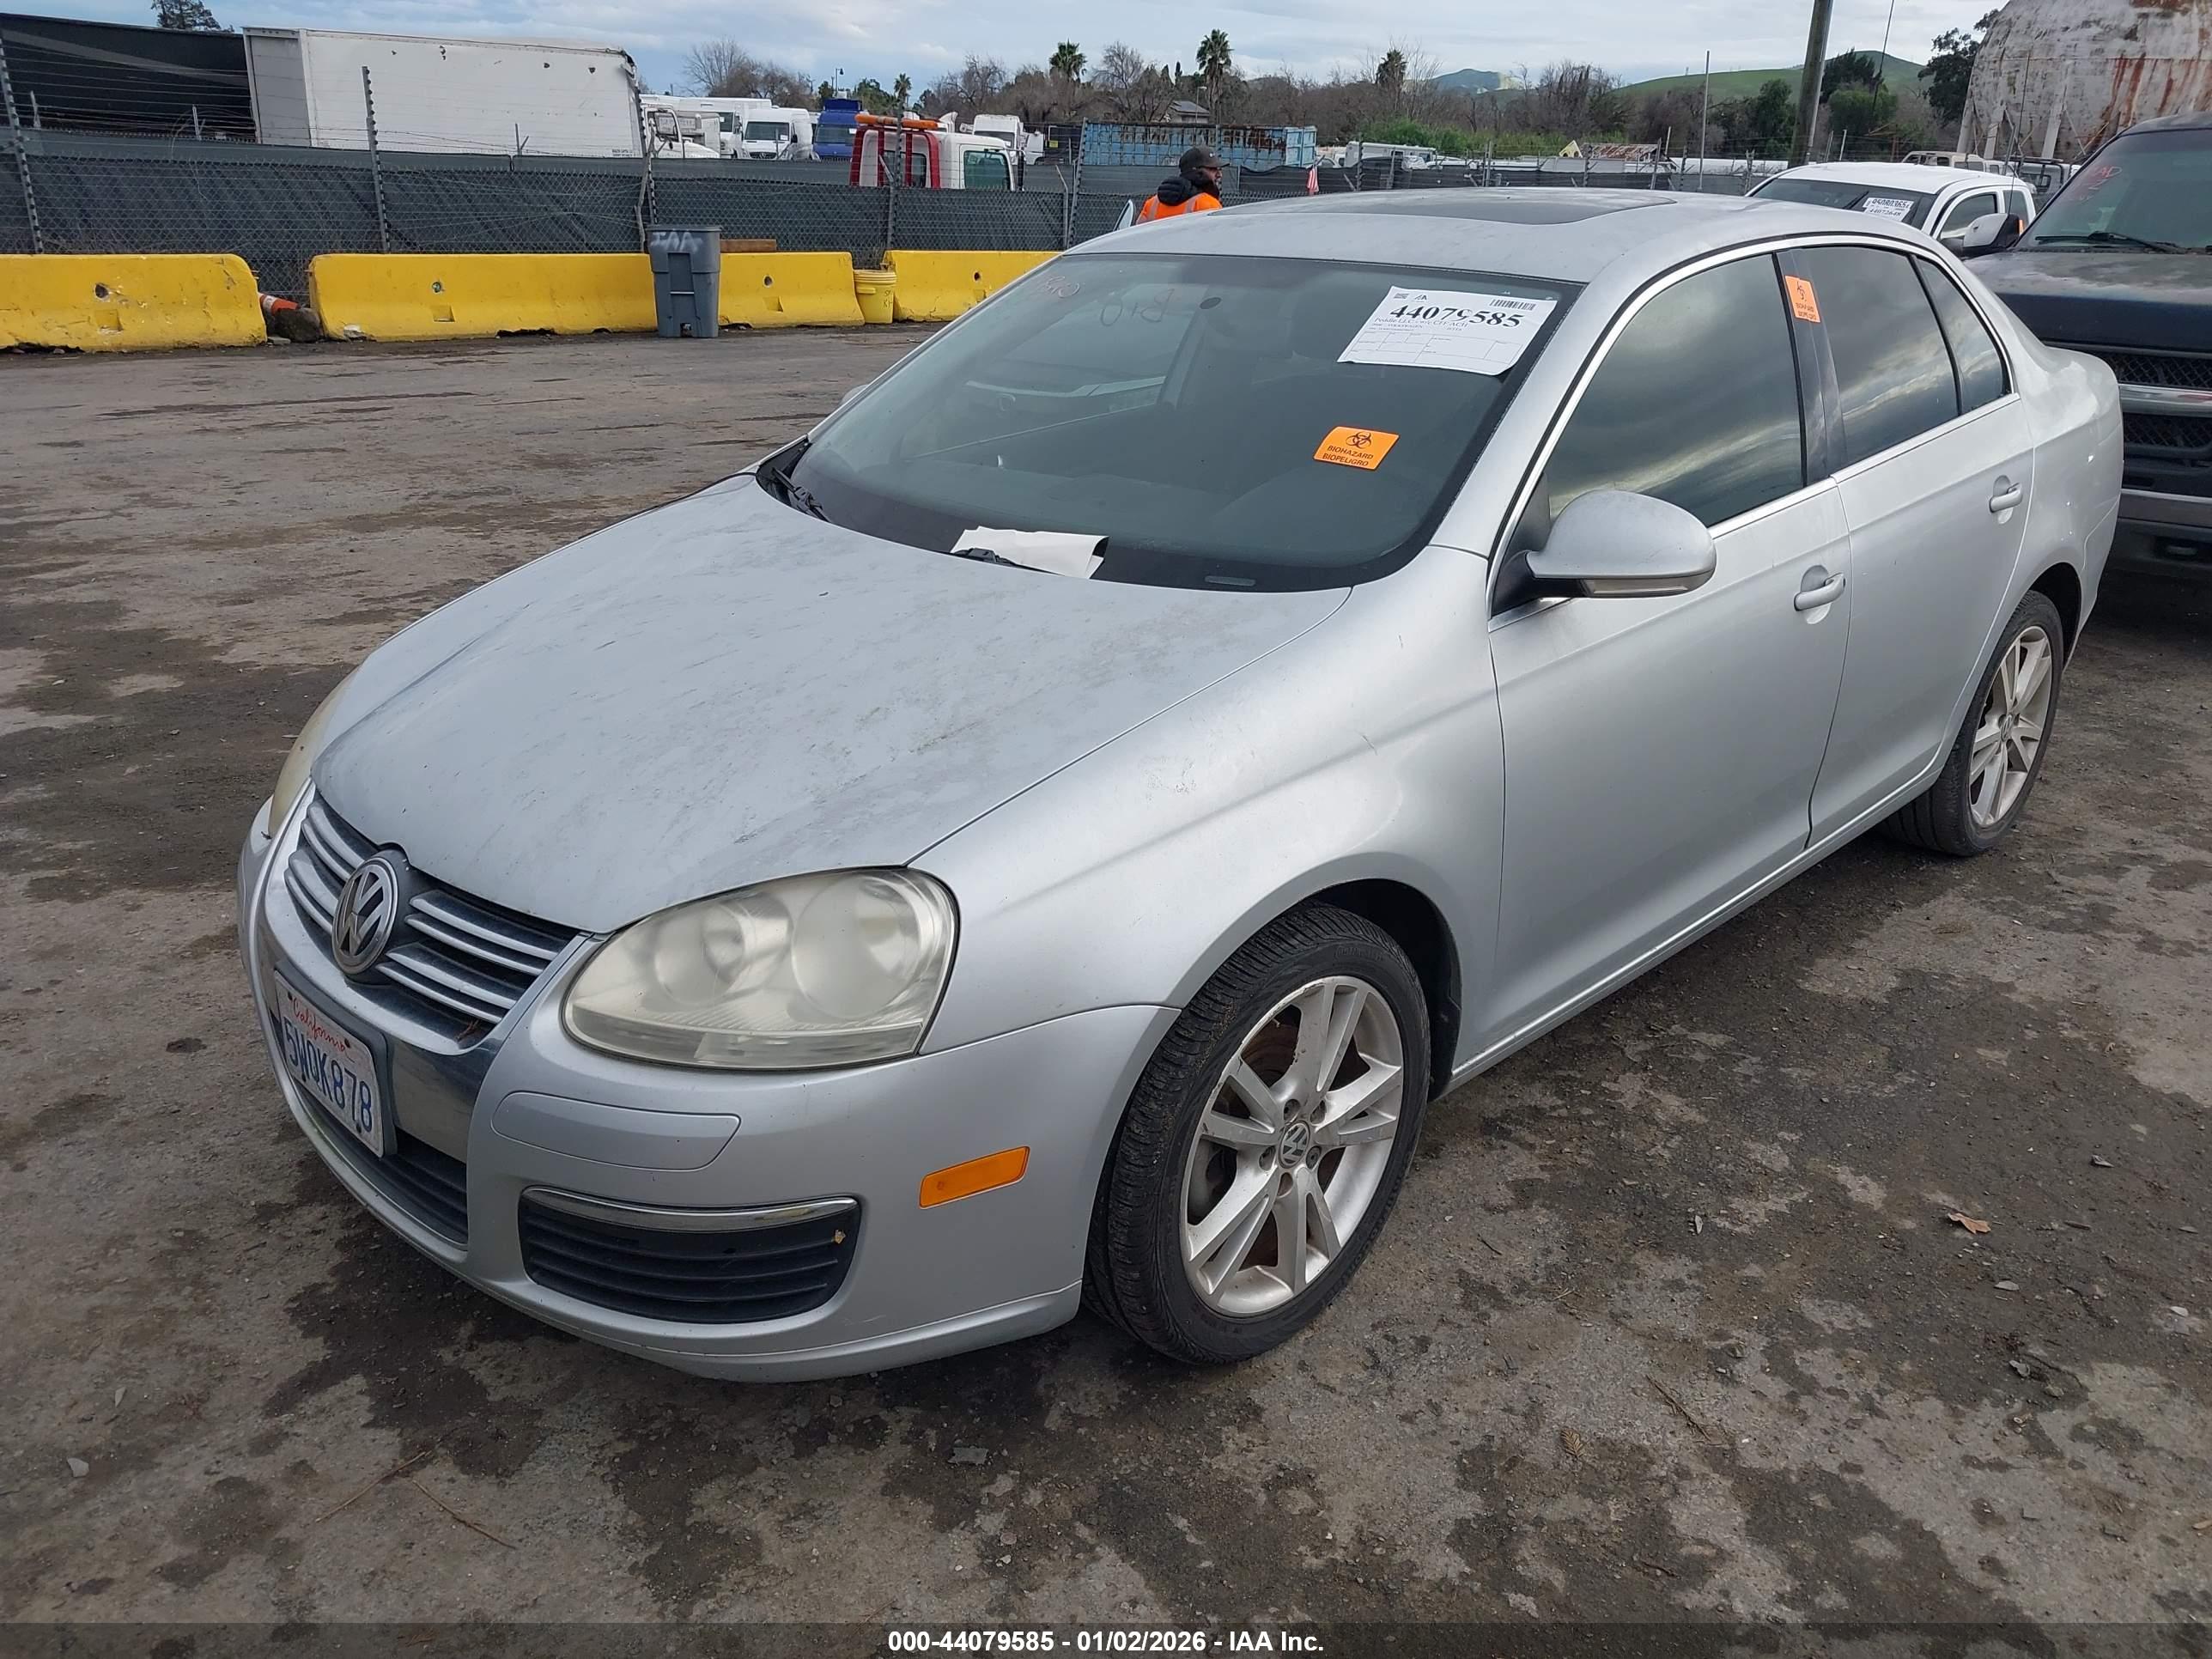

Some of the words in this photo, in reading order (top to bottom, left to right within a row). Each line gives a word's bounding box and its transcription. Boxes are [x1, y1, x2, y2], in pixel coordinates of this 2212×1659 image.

[1389, 305, 1525, 327] 44079585
[1322, 453, 1369, 466] BIOPELIGRO
[1327, 445, 1374, 459] BIOHAZARD
[291, 997, 355, 1061] California
[283, 1016, 373, 1133] 5WQK878
